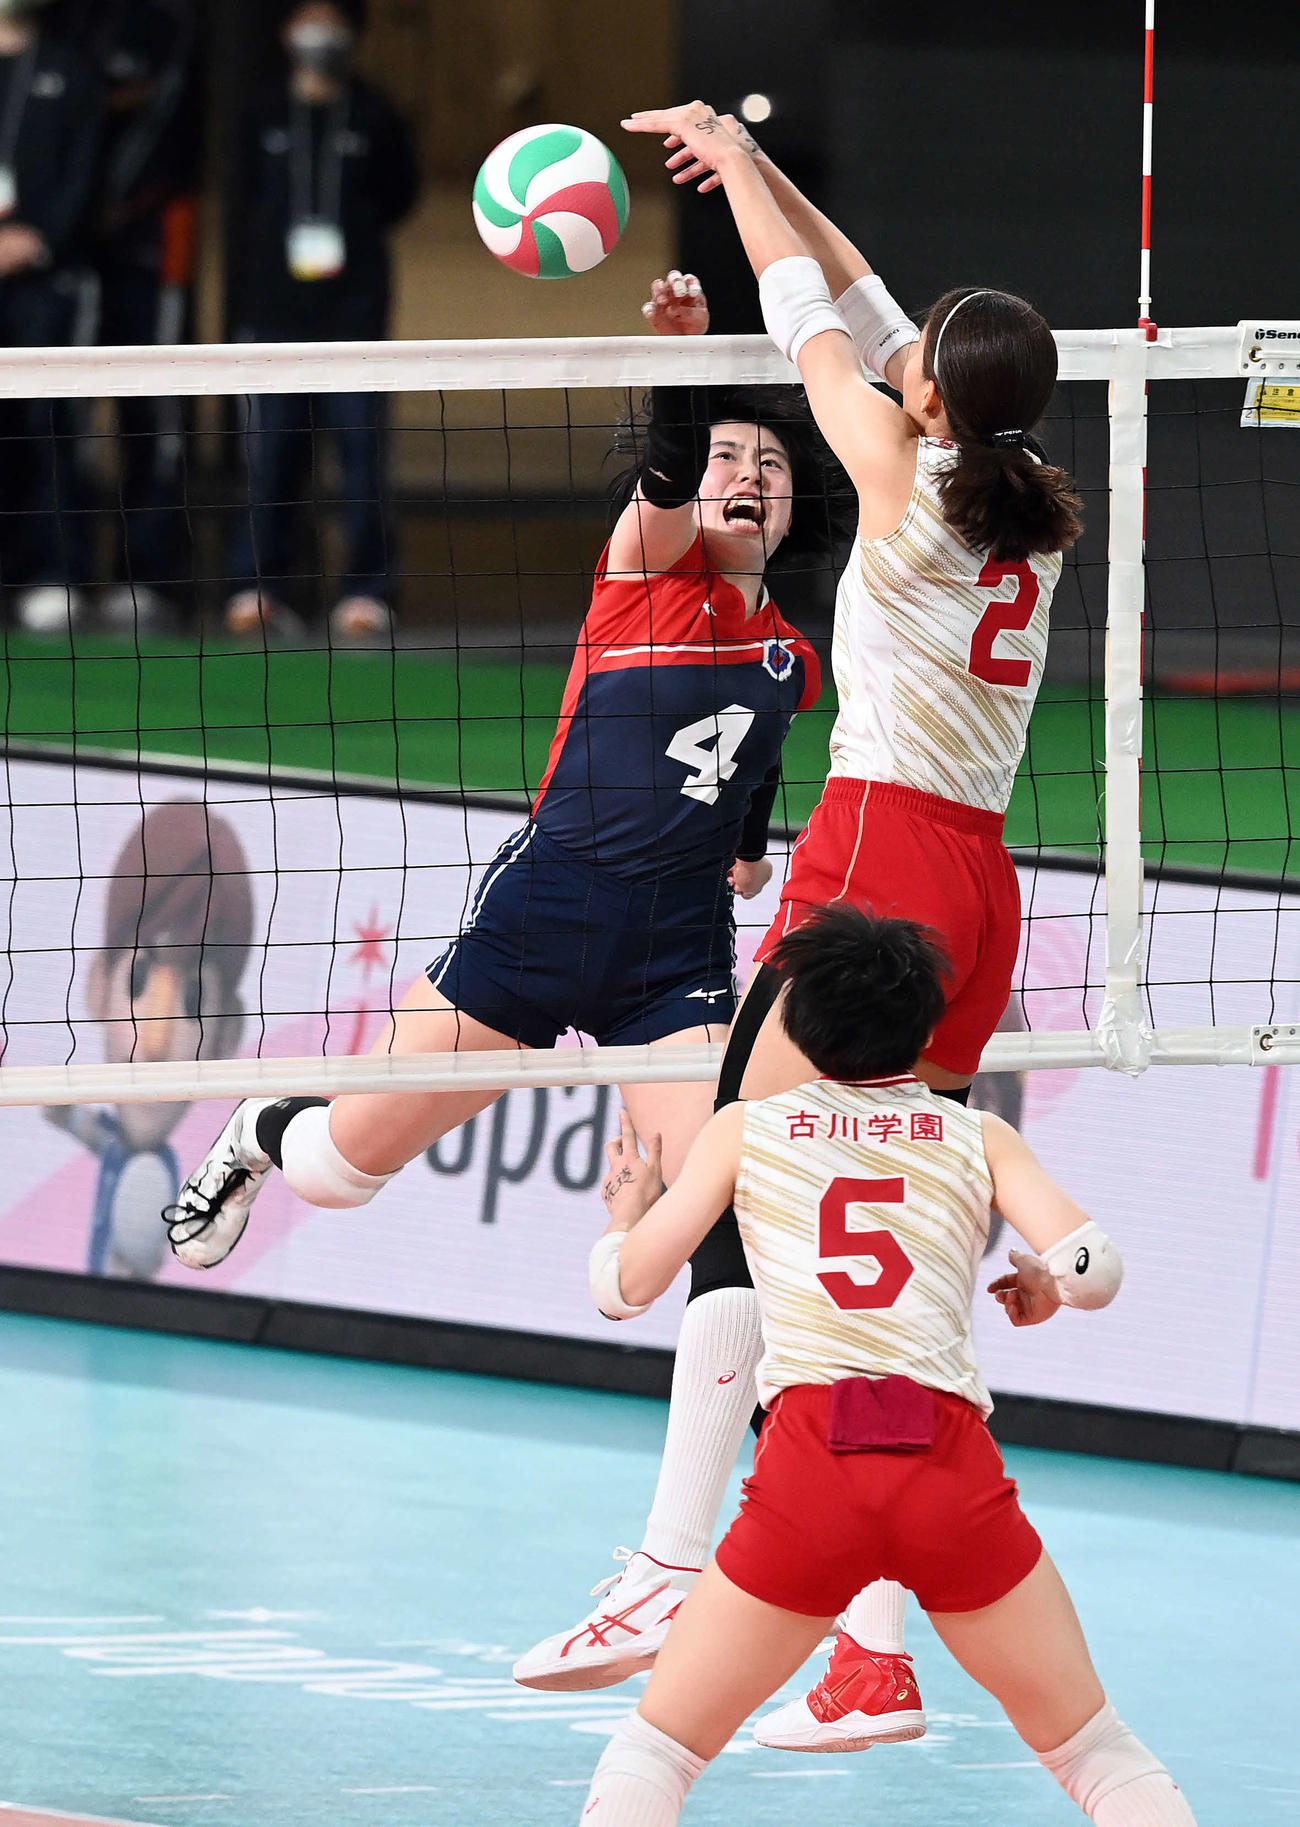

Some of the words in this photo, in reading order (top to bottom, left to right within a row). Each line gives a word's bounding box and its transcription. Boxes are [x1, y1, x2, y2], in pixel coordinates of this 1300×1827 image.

[968, 549, 1040, 687] 2
[665, 703, 756, 806] 4
[786, 1110, 943, 1143] 古川学園
[816, 1176, 915, 1310] 5
